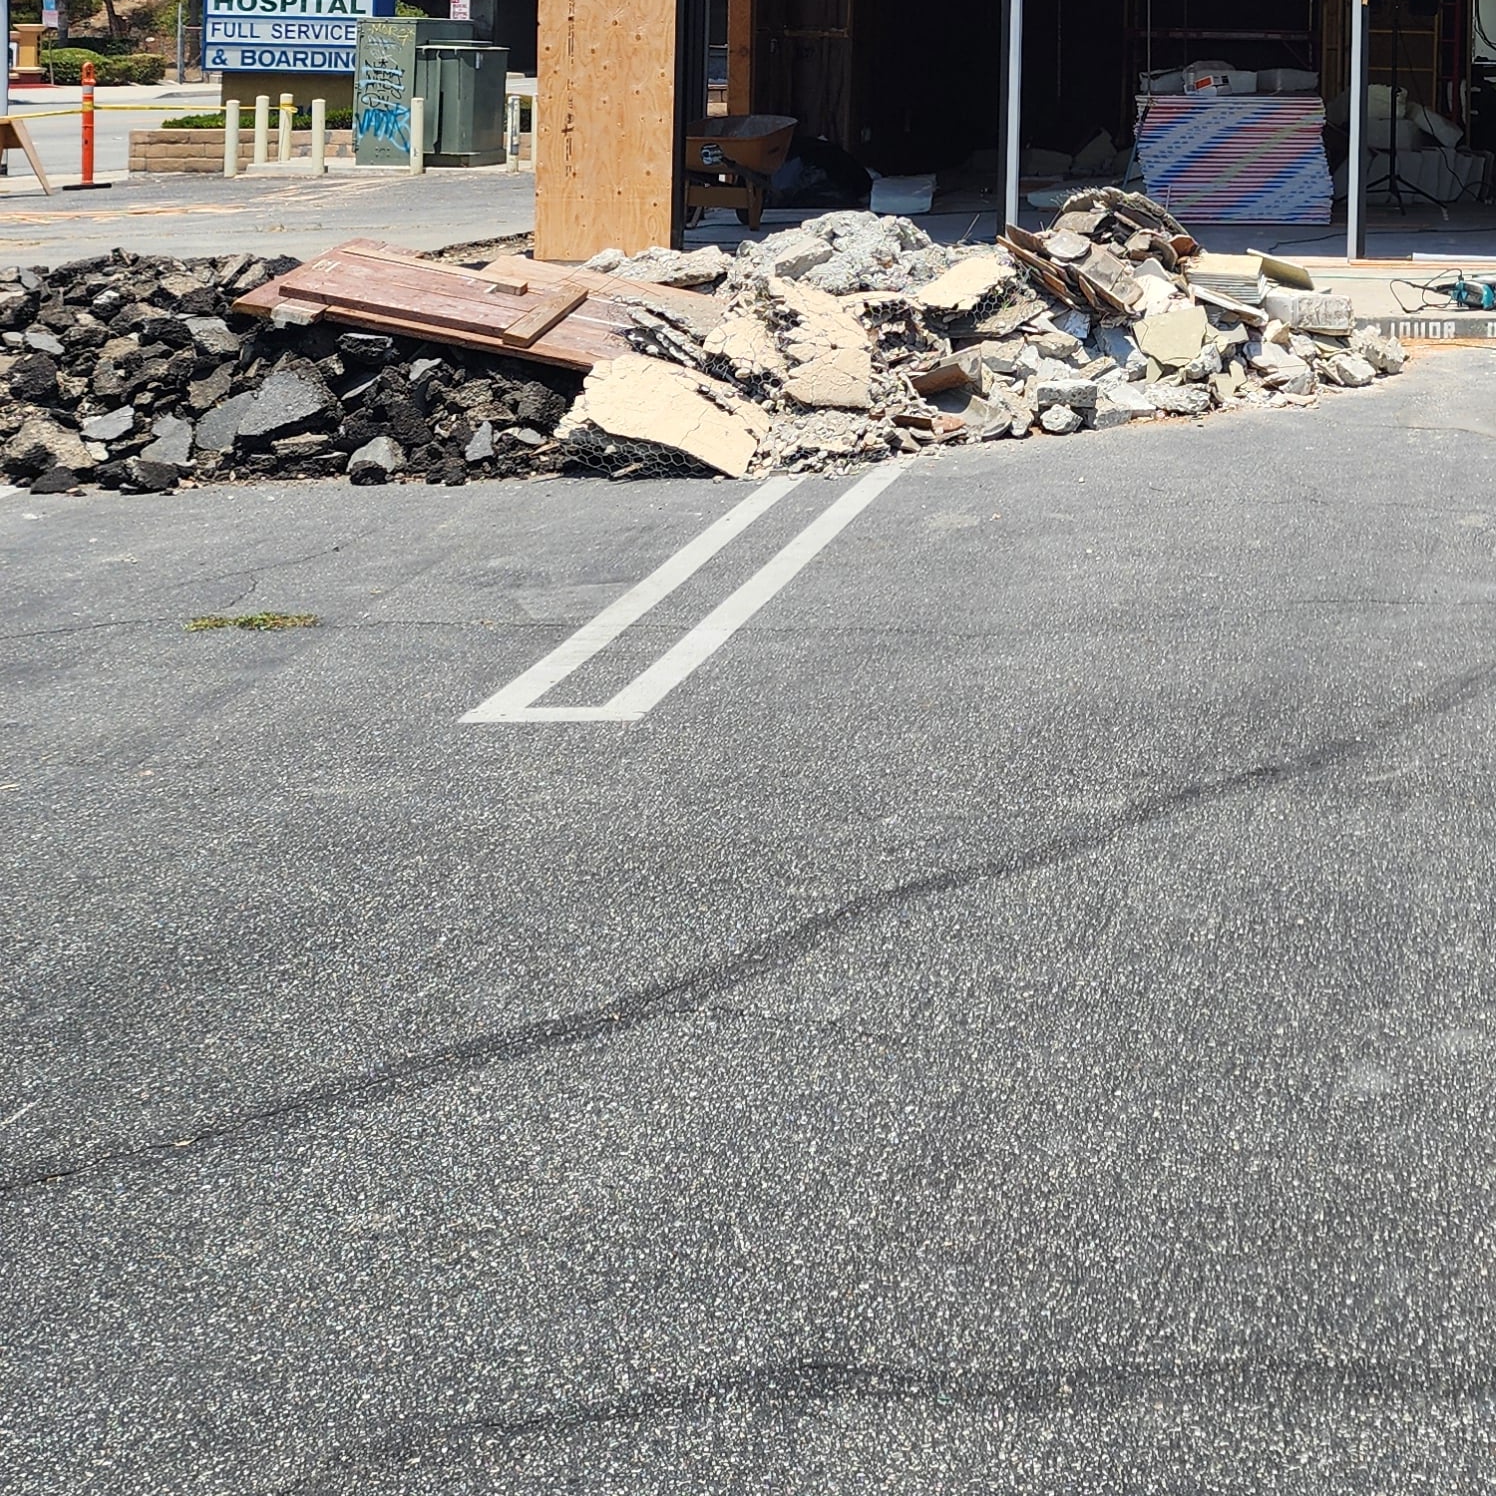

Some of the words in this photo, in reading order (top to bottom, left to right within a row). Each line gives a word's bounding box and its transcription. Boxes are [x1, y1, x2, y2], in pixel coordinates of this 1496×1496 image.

[211, 22, 261, 39] FULL
[271, 23, 356, 41] SERVICE
[211, 48, 228, 66] &
[240, 49, 357, 69] BOARDIN
[1388, 321, 1456, 339] IQUOR
